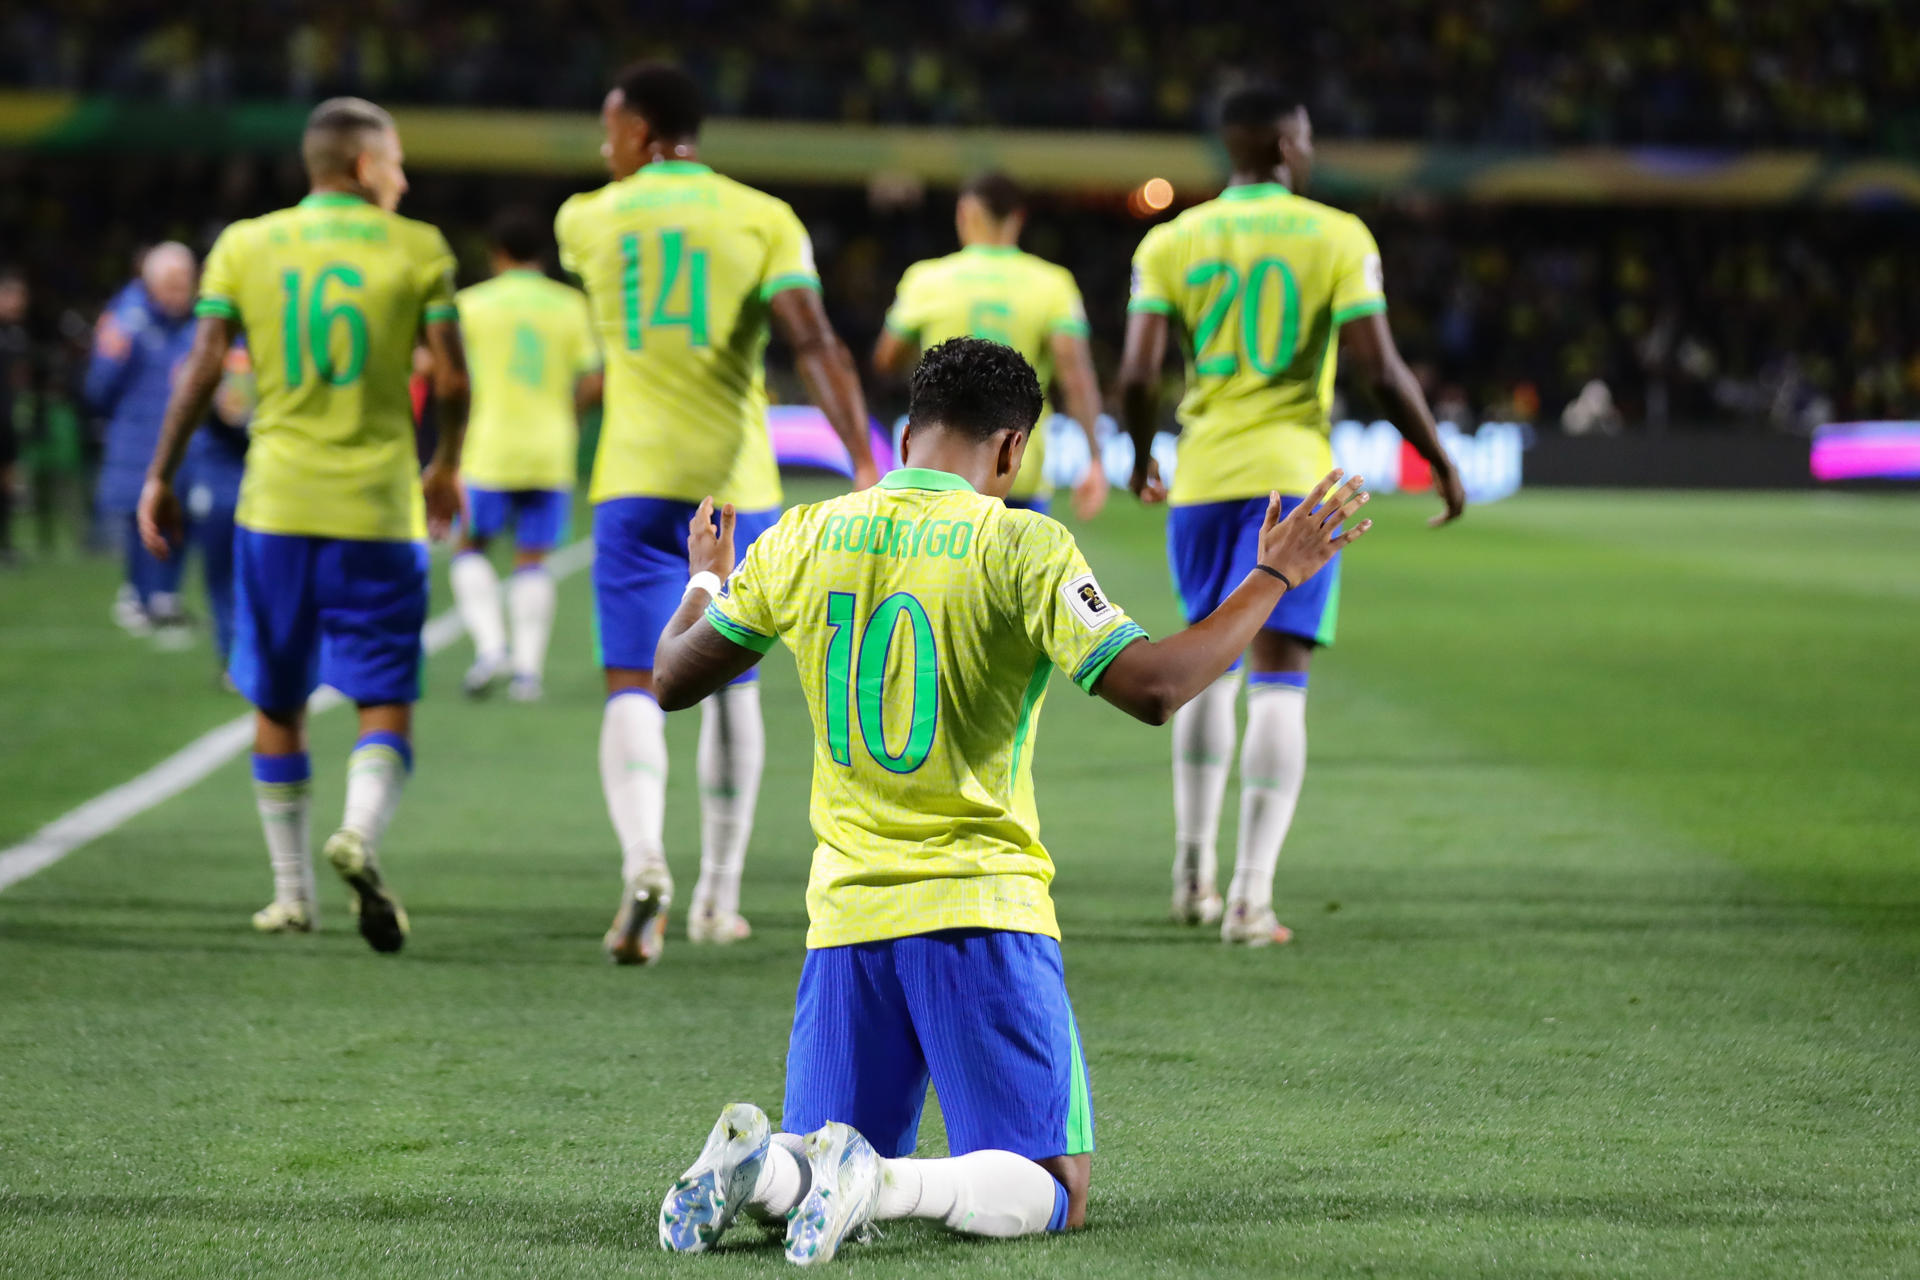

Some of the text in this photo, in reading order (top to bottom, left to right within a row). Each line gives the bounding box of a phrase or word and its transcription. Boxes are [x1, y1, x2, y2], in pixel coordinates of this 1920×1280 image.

[281, 262, 371, 389] 16
[619, 227, 711, 352] 14
[1184, 256, 1303, 379] 20
[821, 515, 974, 559] RODRYGO
[826, 591, 940, 774] 10
